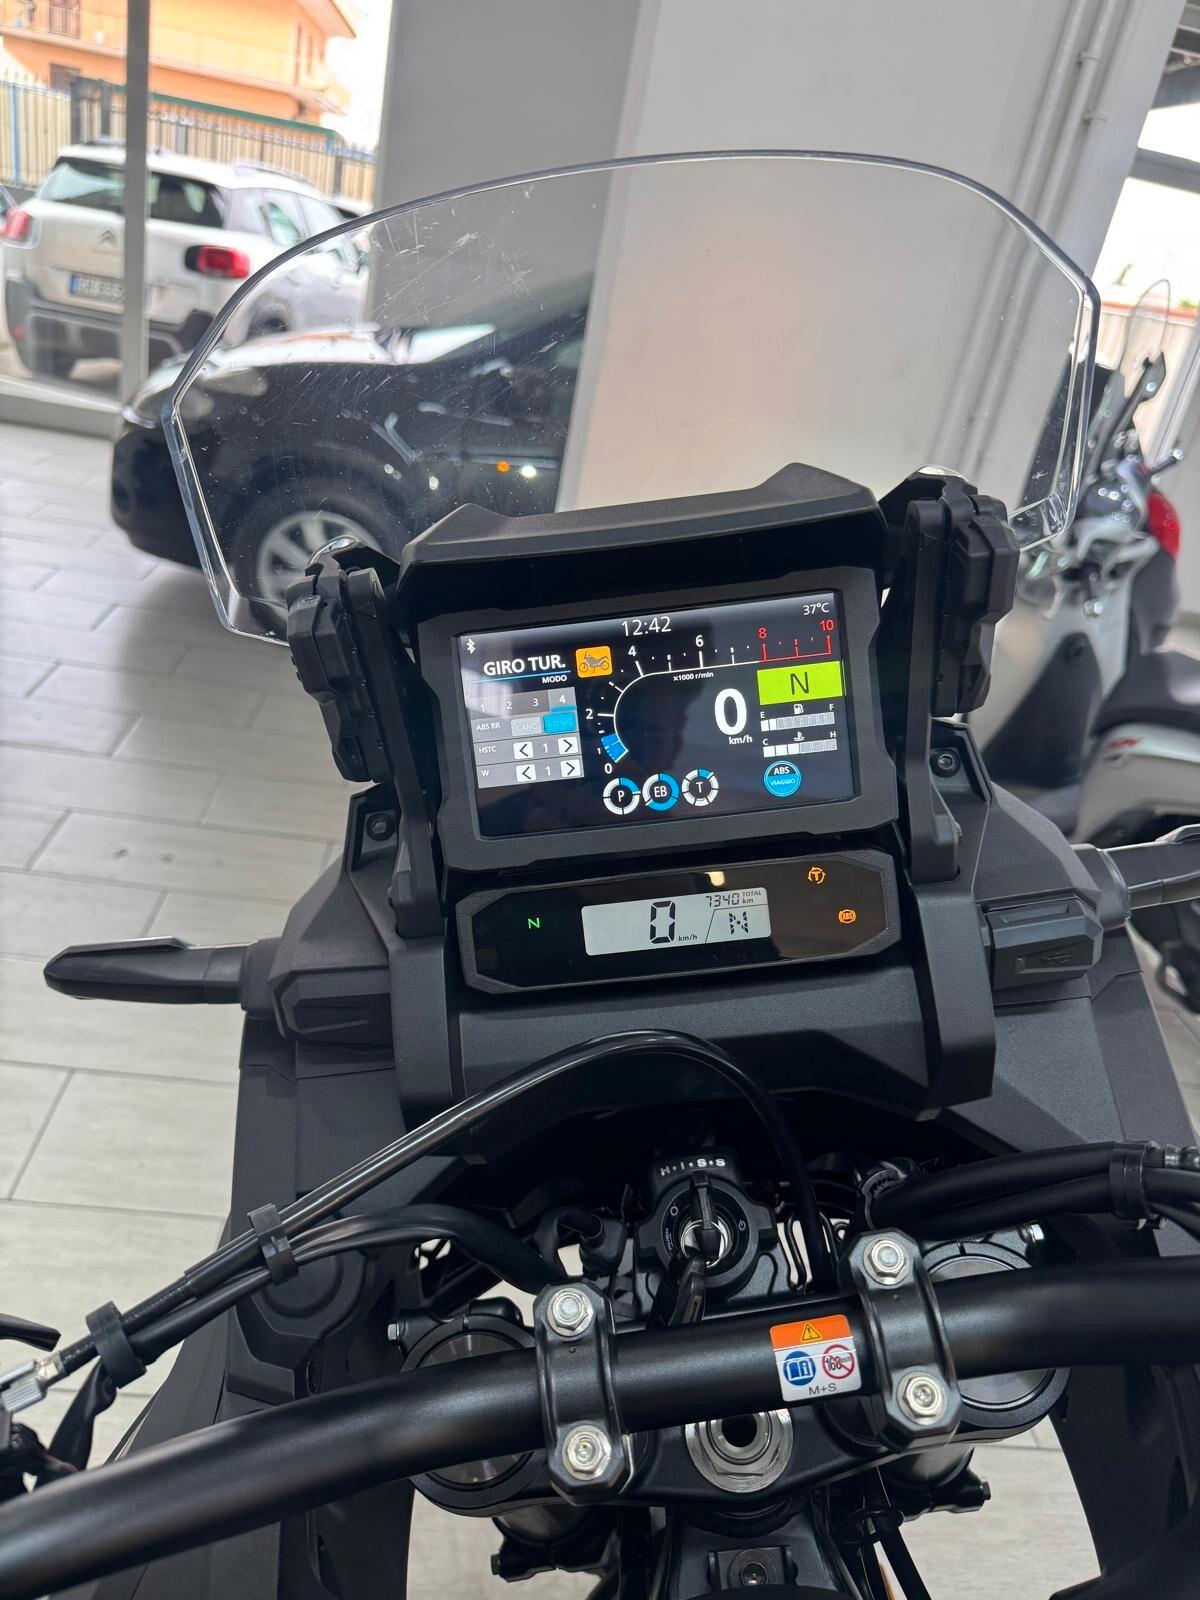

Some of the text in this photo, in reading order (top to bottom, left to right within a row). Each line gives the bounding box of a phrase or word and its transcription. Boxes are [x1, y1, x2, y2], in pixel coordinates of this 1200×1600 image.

[621, 616, 672, 636] 12:42
[820, 619, 834, 632] 10
[758, 627, 767, 639] 8
[695, 634, 704, 648] 6
[628, 645, 637, 657] 4
[484, 655, 566, 676] GIRO TUR.
[542, 674, 568, 684] MODO
[790, 672, 810, 695] N
[532, 698, 540, 707] 3
[559, 695, 567, 704] 4
[829, 703, 835, 711] F
[585, 708, 594, 720] 2
[714, 688, 747, 735] 0
[760, 711, 766, 719] E
[476, 723, 490, 731] ABS
[728, 734, 753, 745] km/h
[762, 738, 769, 746] C
[543, 743, 549, 754] 1
[481, 766, 551, 777] W 1
[604, 762, 613, 775] 0
[773, 766, 790, 776] ABS
[653, 785, 668, 798] EB
[695, 781, 704, 793] T
[617, 790, 625, 802] P
[705, 890, 762, 908] 7340 TOTAL
[527, 917, 541, 930] N
[650, 900, 676, 945] 0
[729, 911, 749, 936] N
[808, 1382, 838, 1396] M+S
